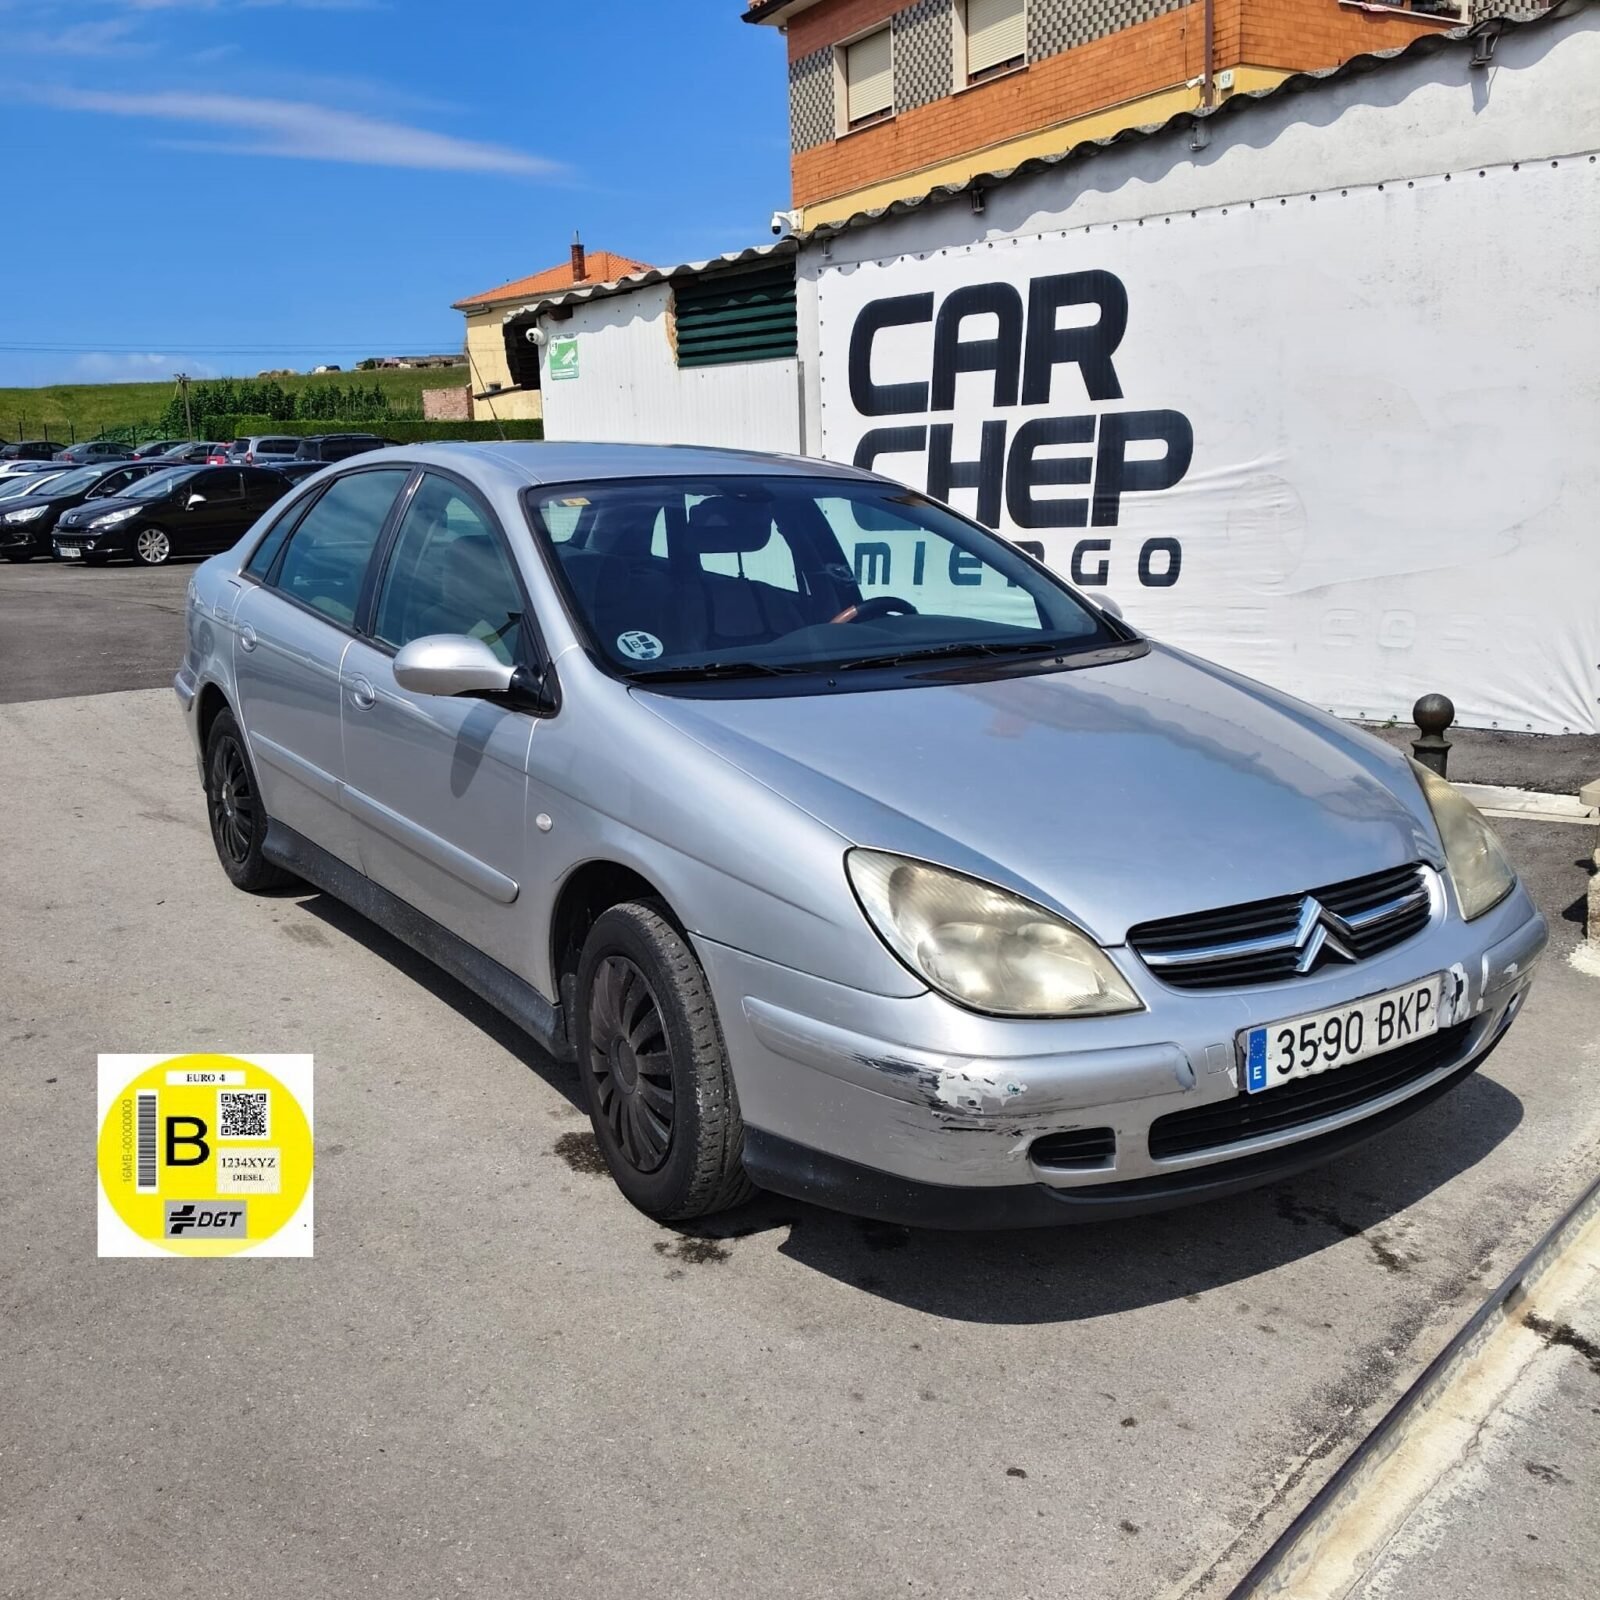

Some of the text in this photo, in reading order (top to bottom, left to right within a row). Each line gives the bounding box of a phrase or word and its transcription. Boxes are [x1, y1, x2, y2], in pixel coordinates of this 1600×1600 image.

[848, 269, 1128, 417] CAR
[1253, 987, 1432, 1080] E 3590 BKP
